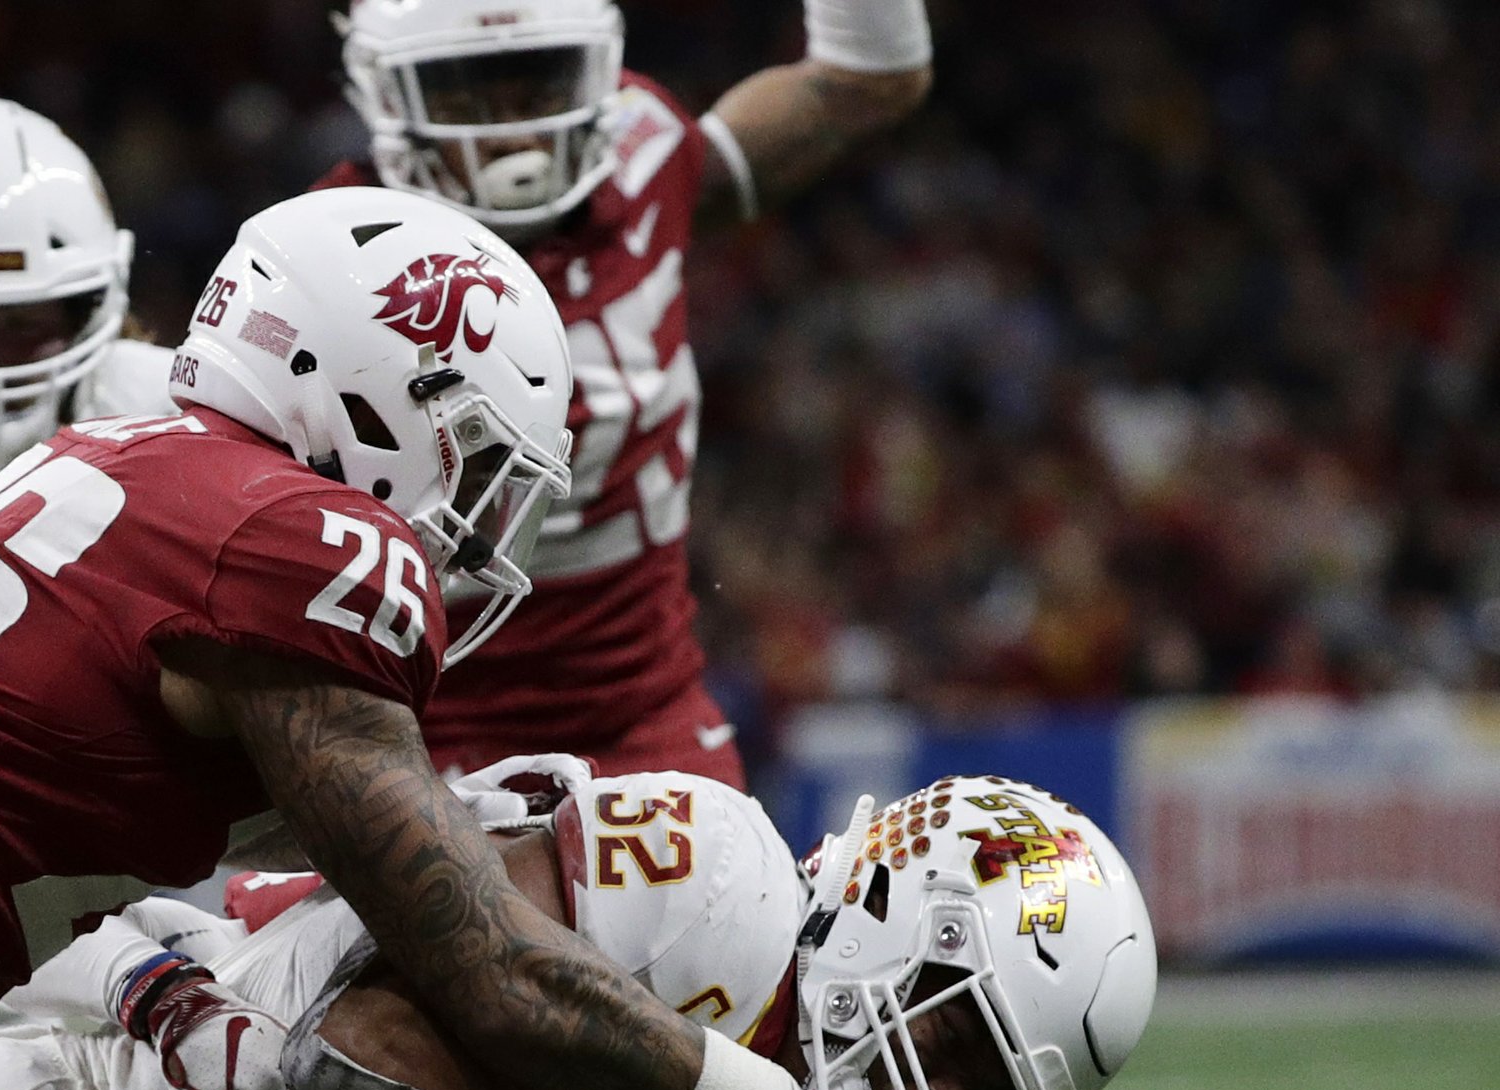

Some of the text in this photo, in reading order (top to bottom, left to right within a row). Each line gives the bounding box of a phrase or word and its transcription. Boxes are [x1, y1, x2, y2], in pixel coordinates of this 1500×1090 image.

[196, 276, 237, 328] 26
[304, 506, 429, 658] 26
[595, 788, 694, 889] 32
[962, 793, 1067, 936] STATE
